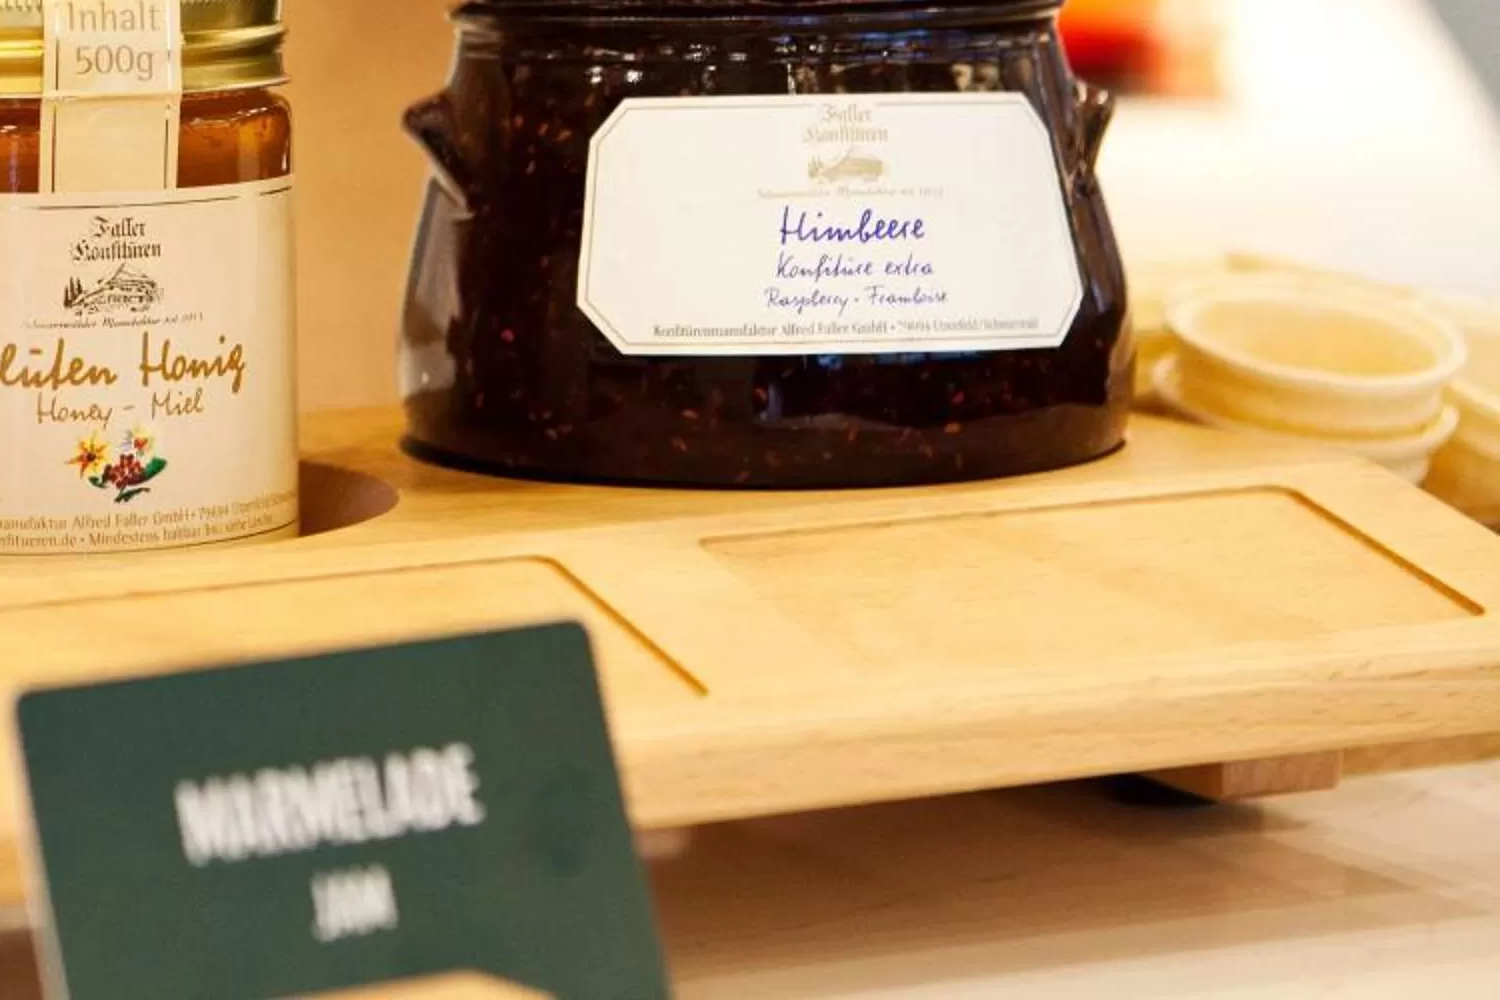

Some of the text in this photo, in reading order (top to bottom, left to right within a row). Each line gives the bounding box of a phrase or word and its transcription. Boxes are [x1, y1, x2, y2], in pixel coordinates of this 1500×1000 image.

[67, 0, 160, 33] Inhalt
[75, 44, 155, 81] 500g
[93, 216, 147, 238] Faller
[780, 205, 926, 245] Himbeere
[884, 252, 934, 276] extra
[140, 331, 245, 393] Honig
[37, 392, 112, 428] Honey
[151, 388, 204, 419] Miel
[174, 743, 486, 867] MARMELADE
